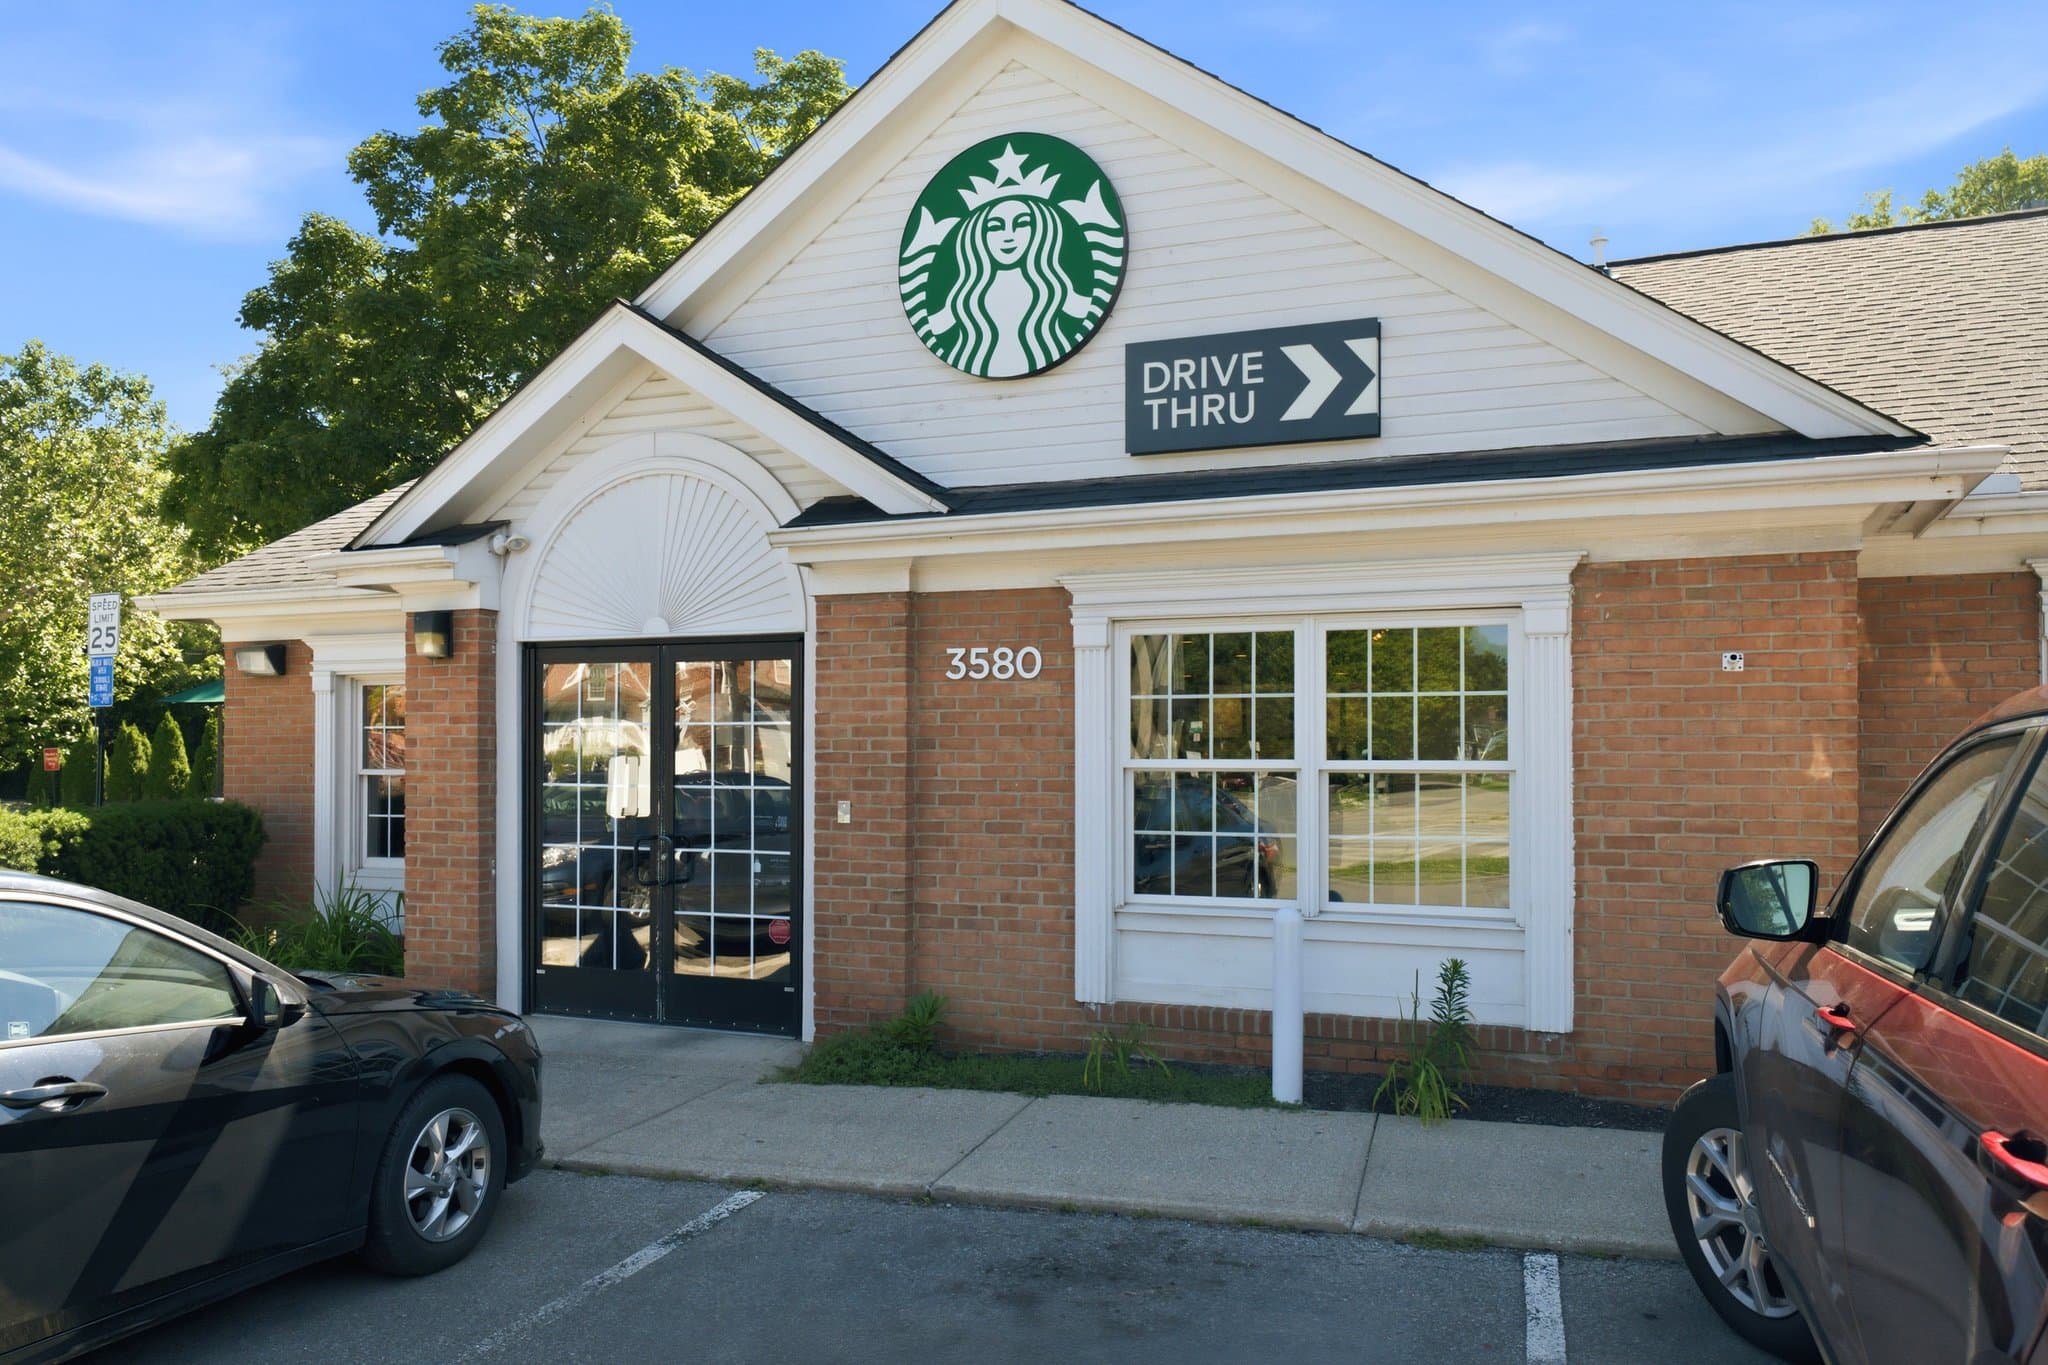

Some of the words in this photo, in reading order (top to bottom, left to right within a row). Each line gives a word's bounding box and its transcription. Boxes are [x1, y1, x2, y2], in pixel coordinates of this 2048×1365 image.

[1143, 351, 1264, 394] DRIVE
[1143, 390, 1255, 431] THRU
[92, 600, 118, 611] SPEED
[94, 613, 114, 624] LIMIT
[91, 626, 116, 649] 25
[945, 646, 1042, 680] 3580
